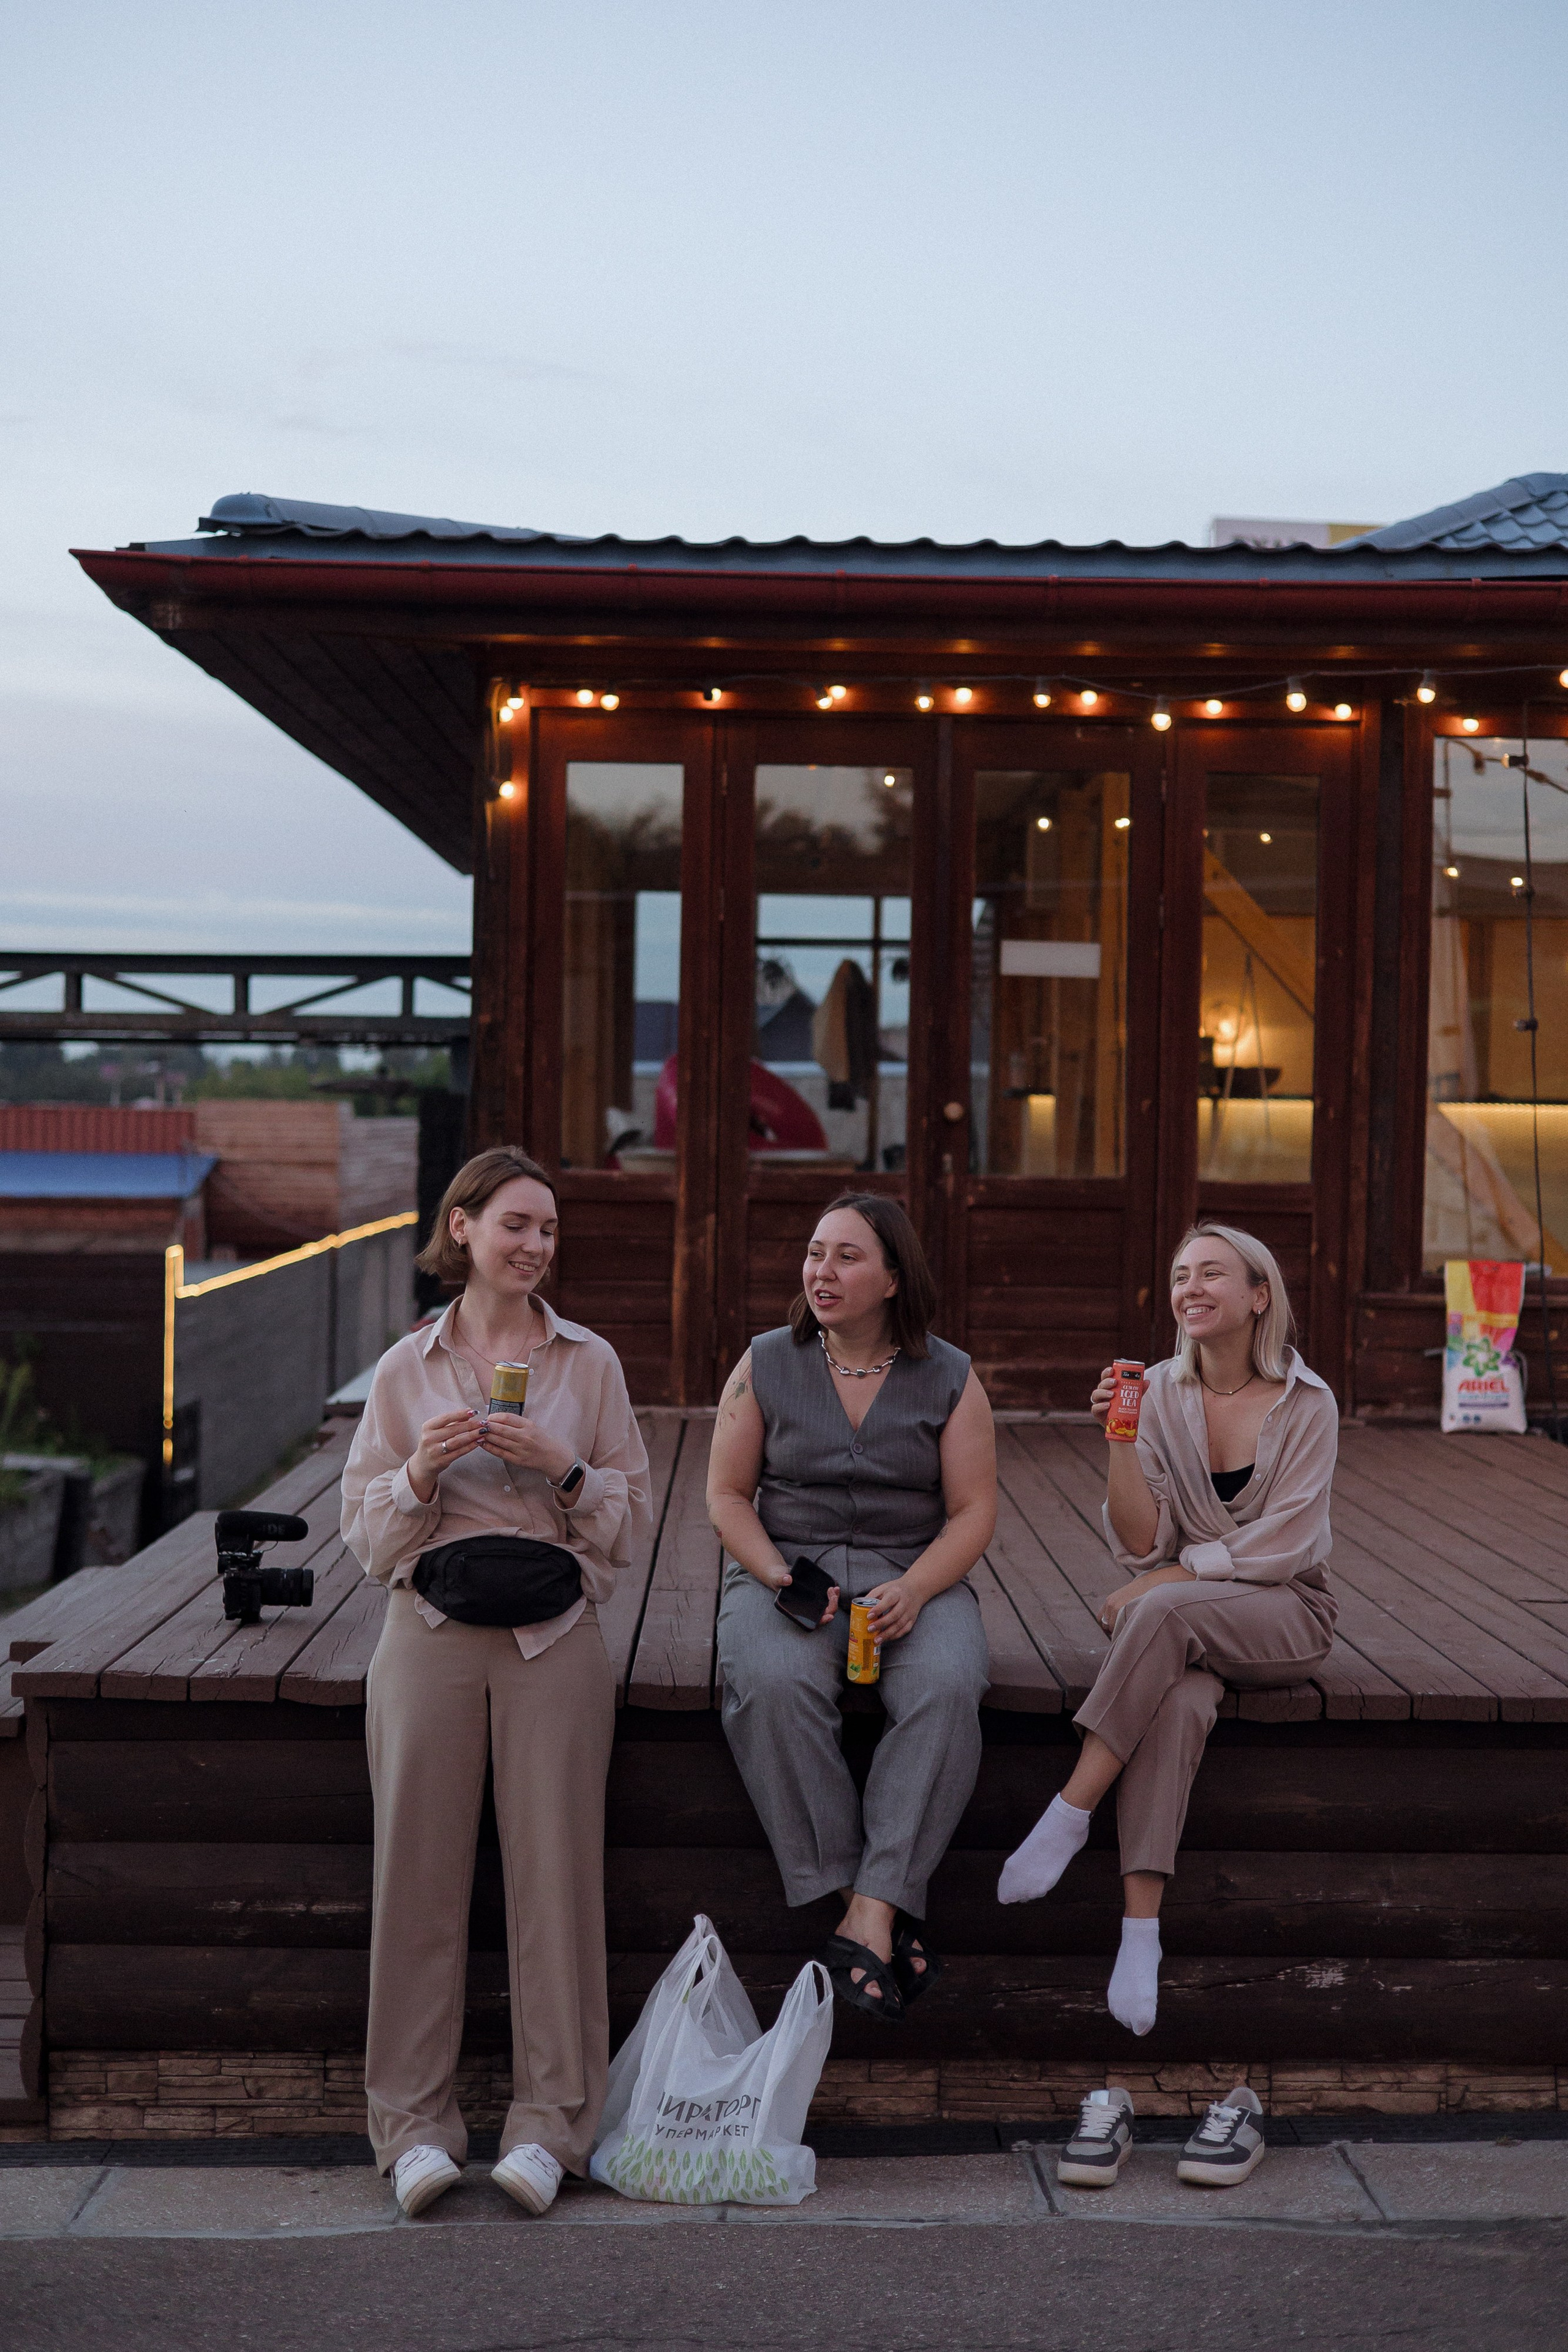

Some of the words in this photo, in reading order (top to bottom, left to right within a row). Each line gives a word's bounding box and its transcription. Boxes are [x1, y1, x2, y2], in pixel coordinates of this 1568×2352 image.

[1120, 1390, 1139, 1398] ICED
[1122, 1398, 1136, 1407] TEA
[655, 2124, 749, 2141] УПЕРМАРКЕТ
